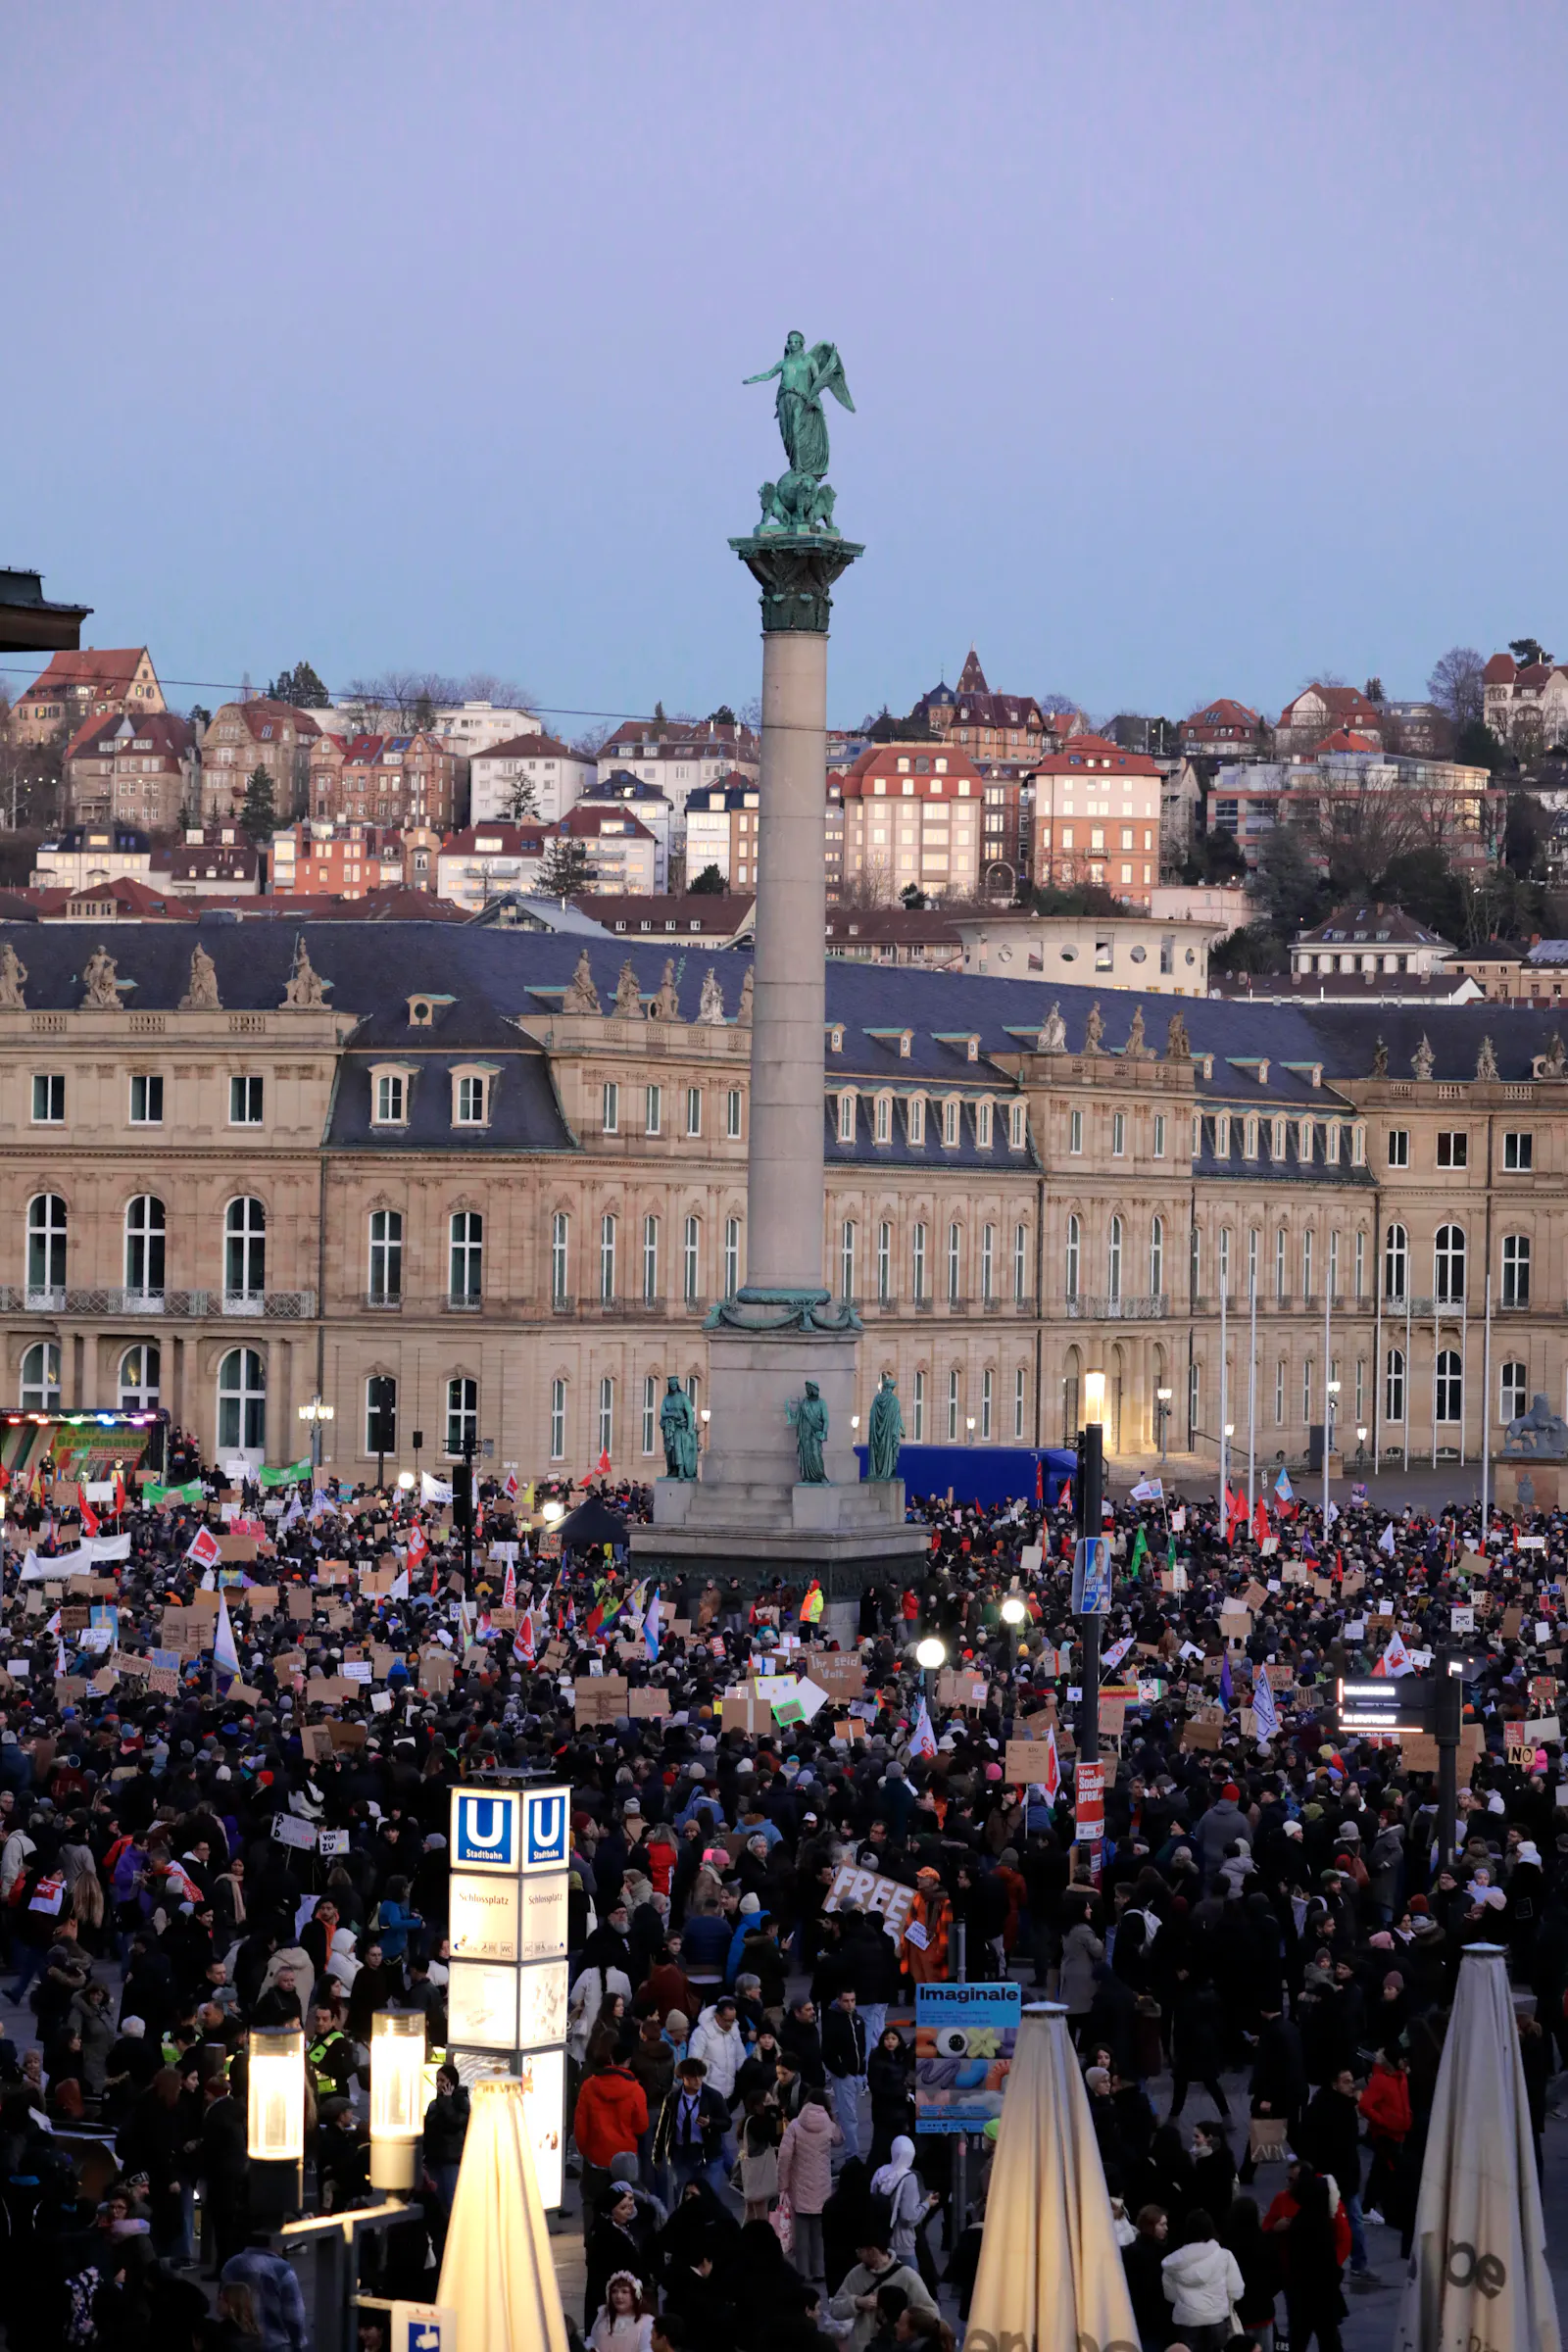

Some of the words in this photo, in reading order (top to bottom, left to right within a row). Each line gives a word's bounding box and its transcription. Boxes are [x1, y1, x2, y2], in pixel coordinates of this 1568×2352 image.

[1511, 1746, 1533, 1763] NO
[466, 1799, 504, 1848] U
[533, 1799, 560, 1847] U
[322, 1842, 334, 1852] ZU
[466, 1848, 503, 1860] Stadtbahn
[533, 1849, 560, 1860] Stadtbahn
[459, 1893, 510, 1907] Schlossplatz
[528, 1893, 564, 1905] Schlossplatz
[834, 1866, 914, 1922] FREE
[920, 1986, 1018, 2004] Imaginale
